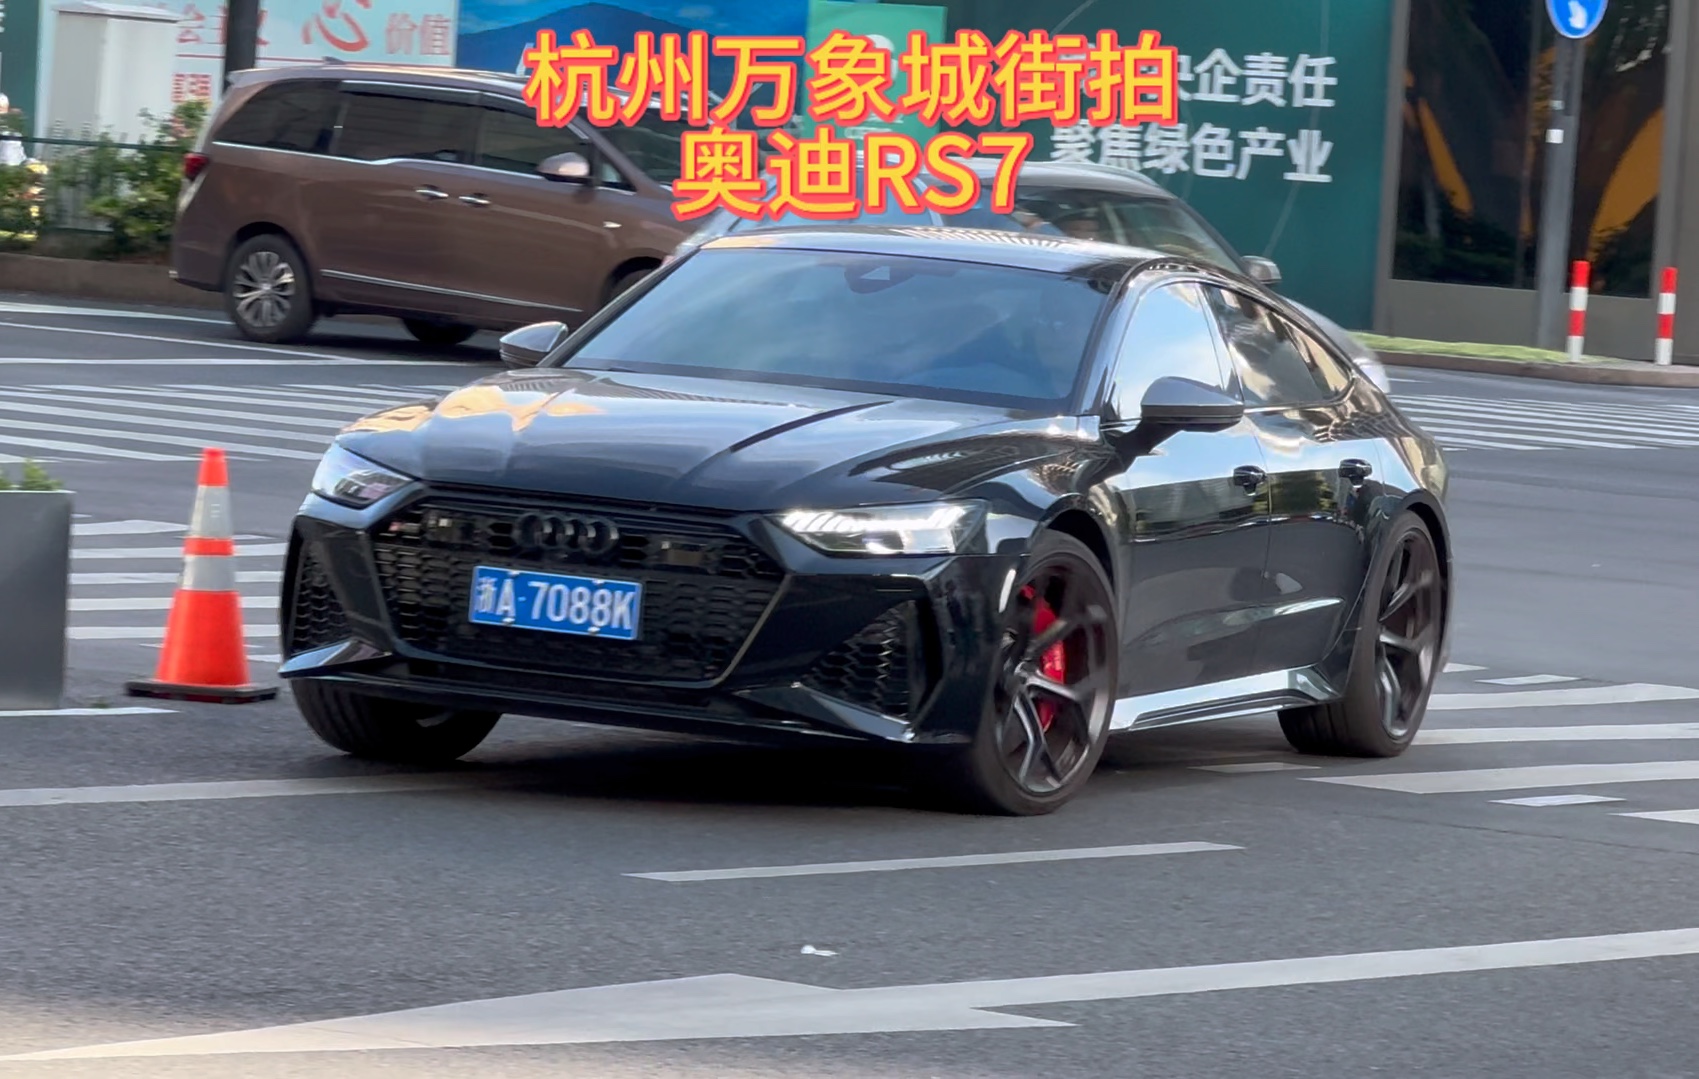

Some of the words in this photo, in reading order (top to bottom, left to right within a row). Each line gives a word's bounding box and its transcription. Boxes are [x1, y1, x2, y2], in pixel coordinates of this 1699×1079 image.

[385, 12, 451, 55] 价值
[1050, 118, 1334, 183] 聚焦绿色产业
